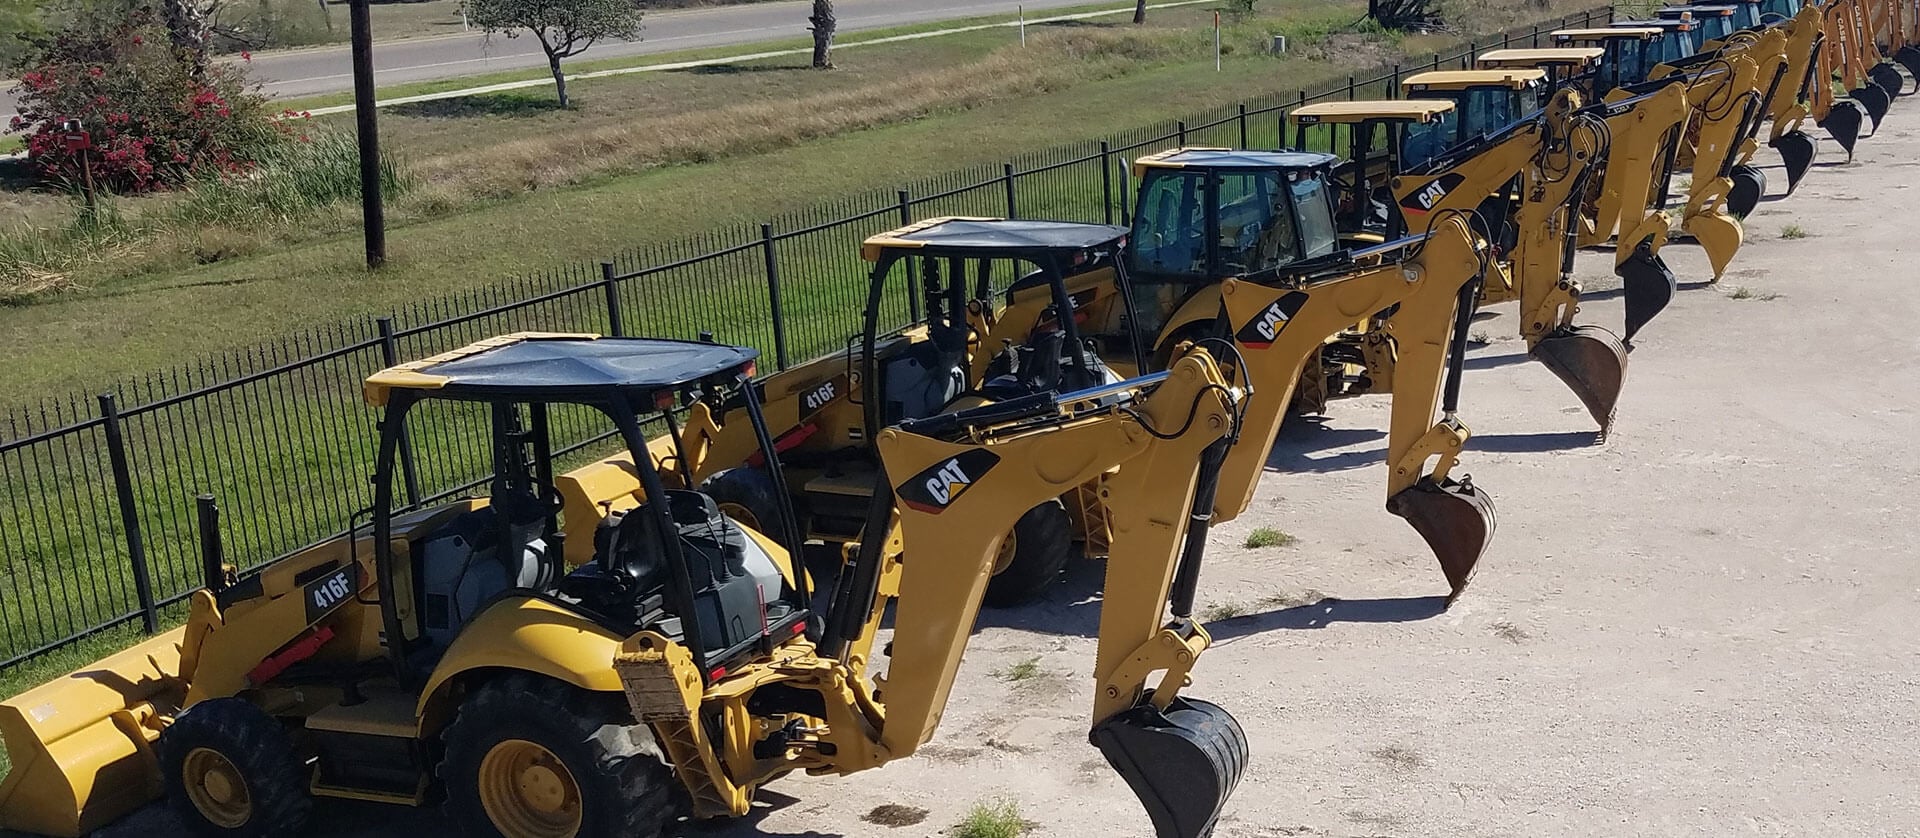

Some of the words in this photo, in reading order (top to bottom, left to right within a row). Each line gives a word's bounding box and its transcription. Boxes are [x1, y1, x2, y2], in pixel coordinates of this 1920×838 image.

[1837, 17, 1846, 42] CASE
[1854, 5, 1863, 28] CASE
[1418, 179, 1446, 209] CAT
[1255, 302, 1289, 341] CAT
[806, 382, 835, 409] 416F
[926, 458, 971, 505] CAT
[314, 571, 350, 608] 416F
